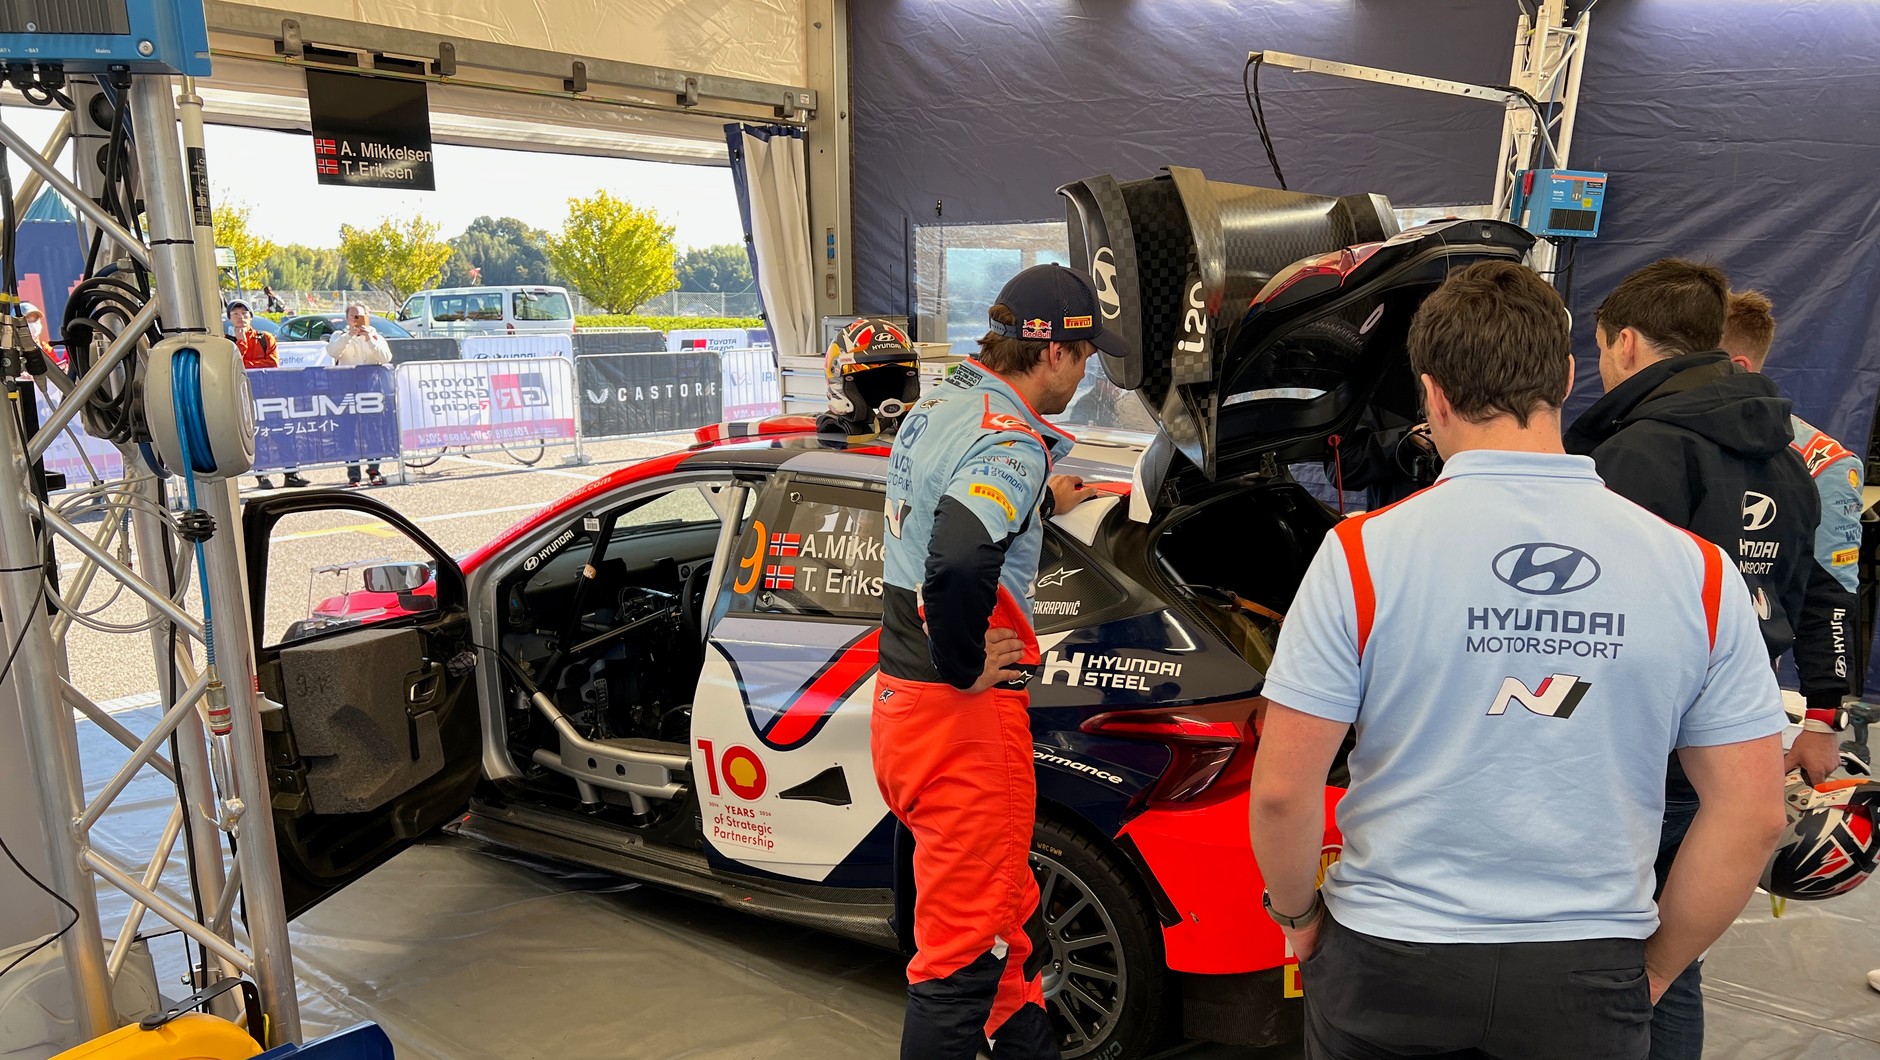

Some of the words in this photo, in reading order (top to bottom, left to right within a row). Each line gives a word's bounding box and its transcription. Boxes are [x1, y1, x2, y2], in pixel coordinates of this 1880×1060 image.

[340, 140, 357, 157] A.
[360, 142, 433, 163] Mikkelsen
[341, 160, 355, 176] T.
[358, 161, 413, 180] Eriksen
[278, 356, 304, 366] gether
[617, 382, 717, 402] CASTORE
[254, 393, 384, 421] RUM8
[538, 529, 575, 561] HYUNDAI
[802, 566, 817, 593] T.
[825, 567, 884, 597] Eriks
[1467, 607, 1626, 637] HYUNDAI
[1465, 636, 1625, 660] MOTORSPORT
[1087, 654, 1183, 677] HYUNDAI
[1083, 672, 1151, 692] STEEL
[697, 738, 768, 802] 10
[1033, 749, 1123, 785] ormance
[724, 804, 756, 819] YEARS
[714, 813, 725, 825] of
[726, 815, 773, 836] Strategic
[713, 825, 775, 850] Partnership
